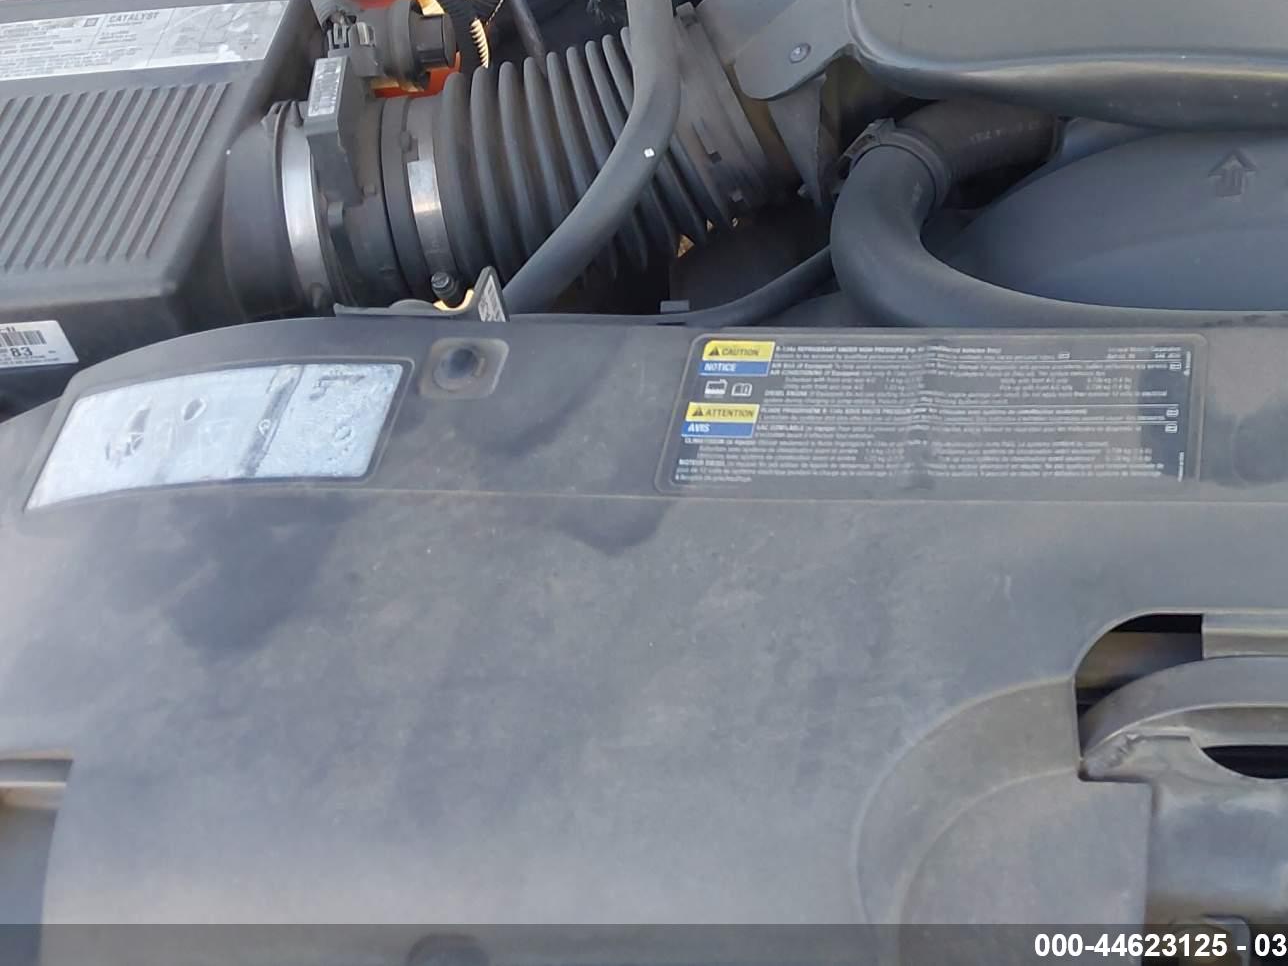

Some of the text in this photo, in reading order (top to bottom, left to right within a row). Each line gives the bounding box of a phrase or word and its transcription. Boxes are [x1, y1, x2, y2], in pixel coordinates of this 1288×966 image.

[721, 347, 760, 356] CAUTION
[704, 362, 737, 372] NOTICE
[704, 408, 754, 418] ATTENTION
[687, 423, 711, 433] AVIS
